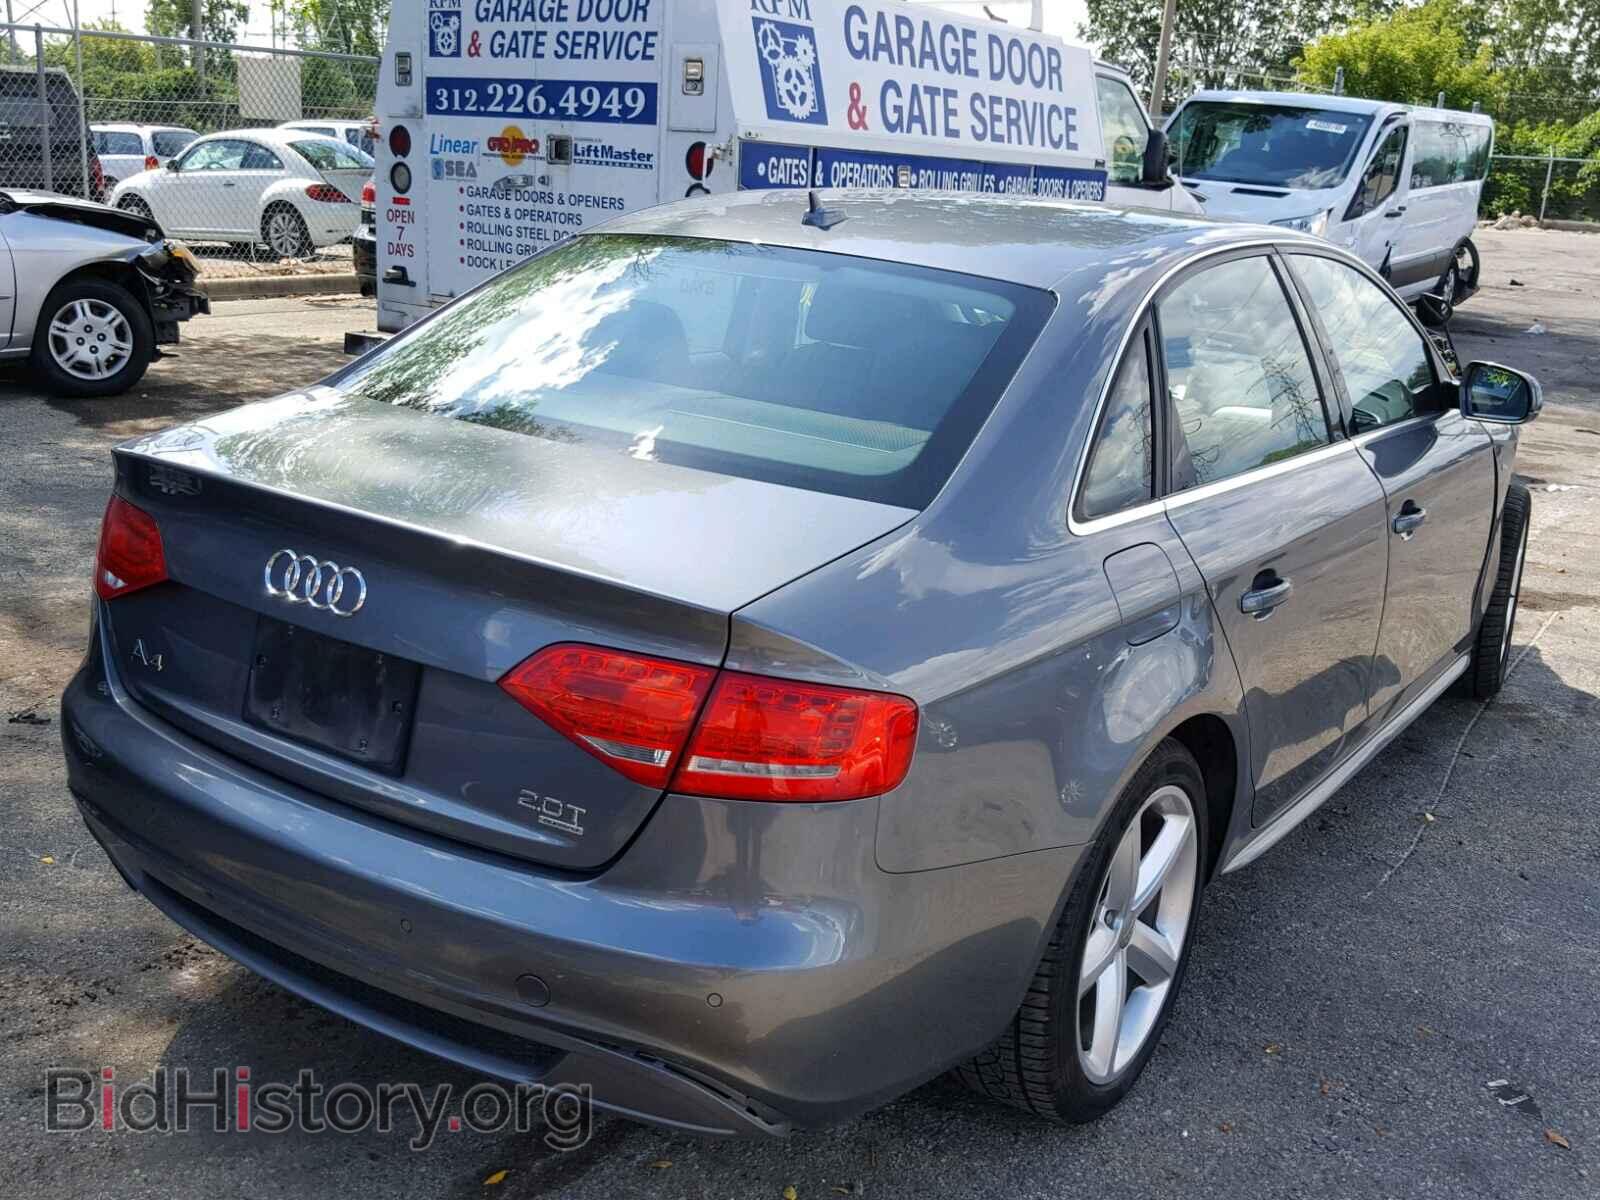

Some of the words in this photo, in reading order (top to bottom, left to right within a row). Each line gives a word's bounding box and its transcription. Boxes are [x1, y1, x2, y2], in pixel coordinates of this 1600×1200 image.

[474, 0, 568, 23] GARAGE
[576, 0, 649, 23] DOOR
[467, 30, 481, 58] &
[490, 30, 548, 59] GATE
[553, 30, 658, 61] SERVICE
[844, 5, 979, 78] GARAGE
[987, 33, 1063, 92] DOOR
[435, 83, 646, 120] 312.226.4949
[847, 82, 869, 131] &
[879, 79, 960, 139] GATE
[970, 92, 1079, 151] SERVICE
[430, 133, 479, 155] Linear
[573, 143, 654, 162] LiftMaster
[445, 160, 478, 178] SEA
[767, 157, 809, 186] GATES
[815, 160, 825, 186] &
[831, 161, 894, 189] OPERATORS
[919, 169, 959, 193] ROLLING
[960, 171, 996, 193] GRILLES
[1004, 175, 1037, 195] GARAGE
[1038, 177, 1063, 198] DOORS
[1071, 180, 1103, 200] OPENERS
[466, 185, 512, 201] GARAGE
[514, 188, 554, 205] DOORS
[557, 192, 566, 206] &
[568, 193, 625, 211] OPENERS
[386, 208, 415, 224] OPEN
[466, 203, 501, 218] GATES
[504, 207, 512, 220] &
[514, 208, 583, 226] OPERATORS
[396, 225, 405, 241] 7
[466, 221, 513, 237] ROLLING
[515, 225, 550, 242] STEEL
[553, 229, 569, 242] DO
[387, 241, 415, 258] DAYS
[466, 238, 513, 255] ROLLING
[466, 255, 497, 271] DOCK
[499, 259, 517, 271] LE
[131, 638, 164, 672] A4
[518, 788, 587, 828] 2.0T
